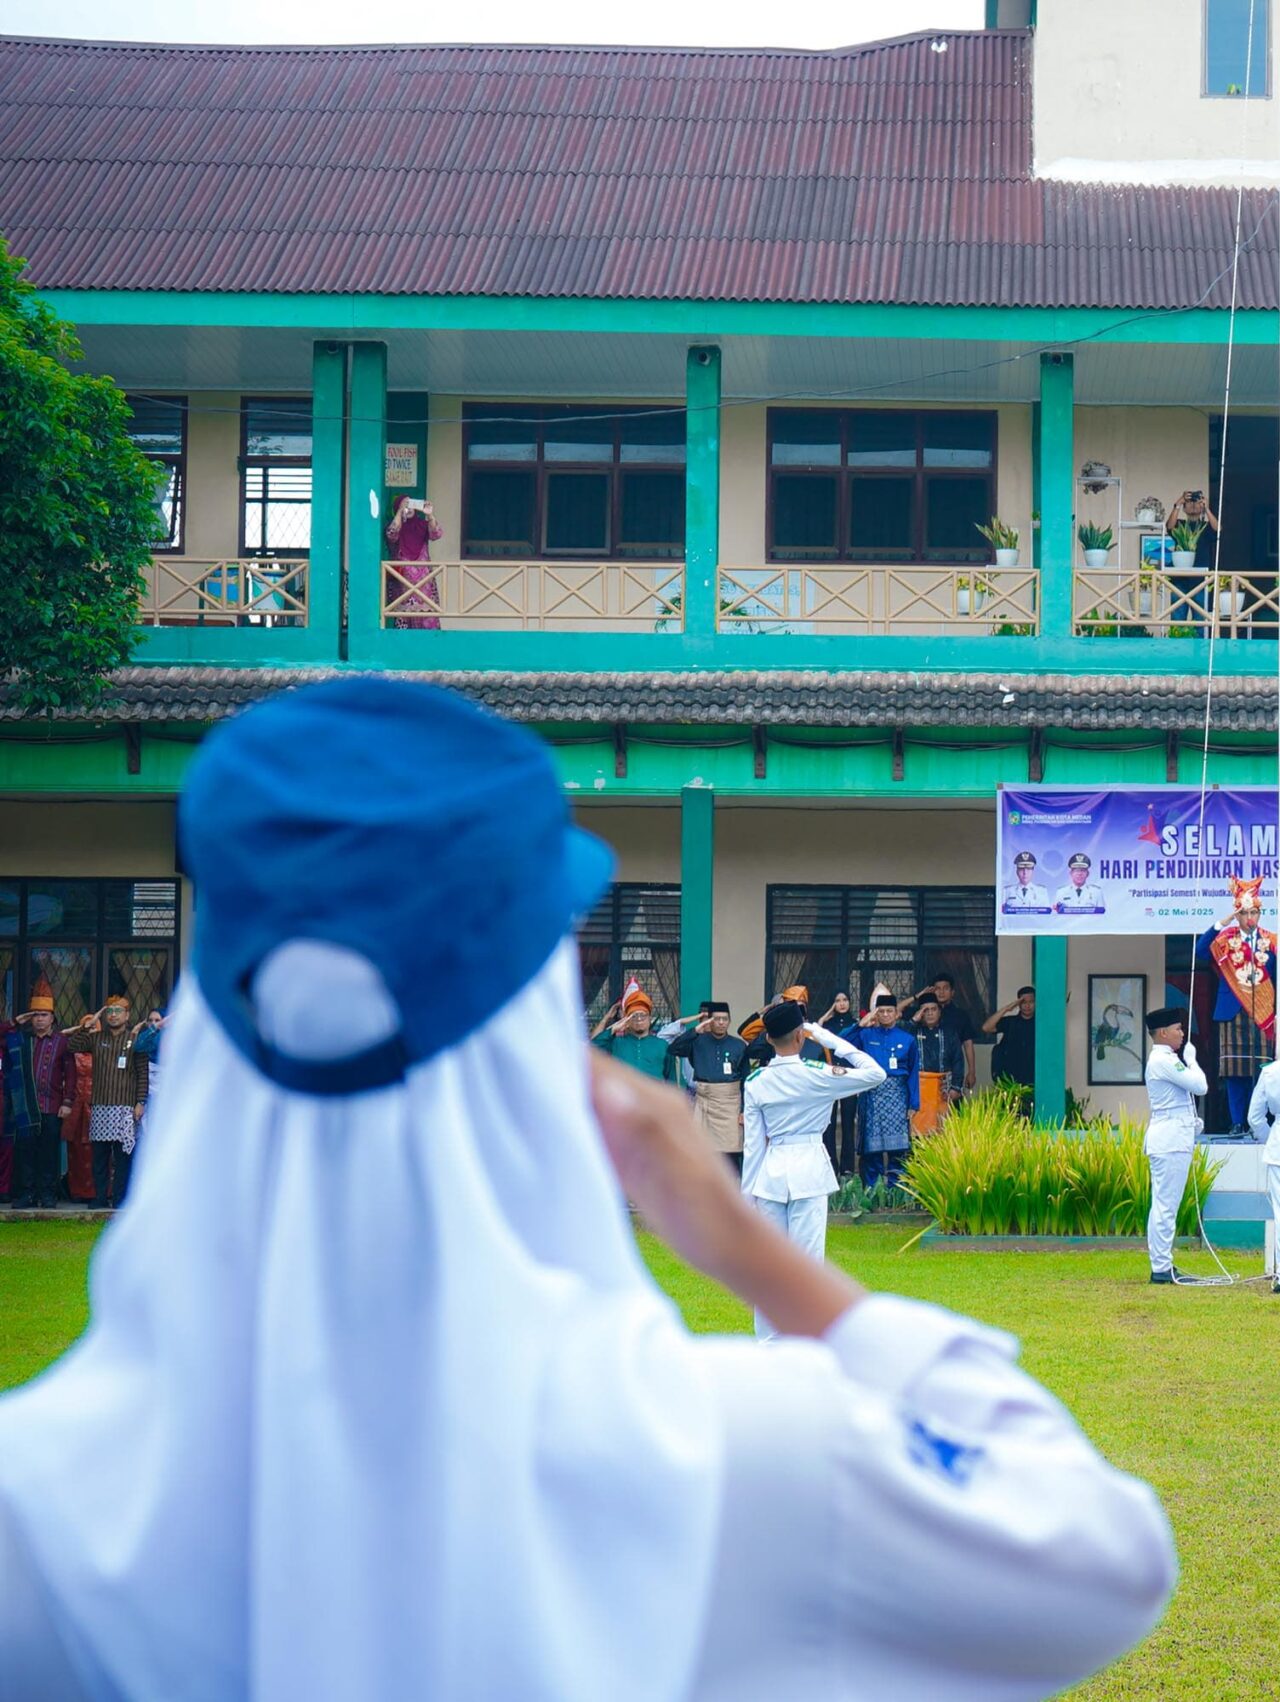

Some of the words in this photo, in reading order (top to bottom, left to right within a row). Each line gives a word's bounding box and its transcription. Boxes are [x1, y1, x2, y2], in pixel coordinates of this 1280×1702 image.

[404, 447, 417, 458] FISH
[393, 459, 411, 470] TWICE
[1100, 860, 1138, 879] HARI
[1146, 860, 1243, 879] PENDIDIKAN
[1171, 889, 1200, 897] Semest
[1191, 908, 1214, 916] 2025
